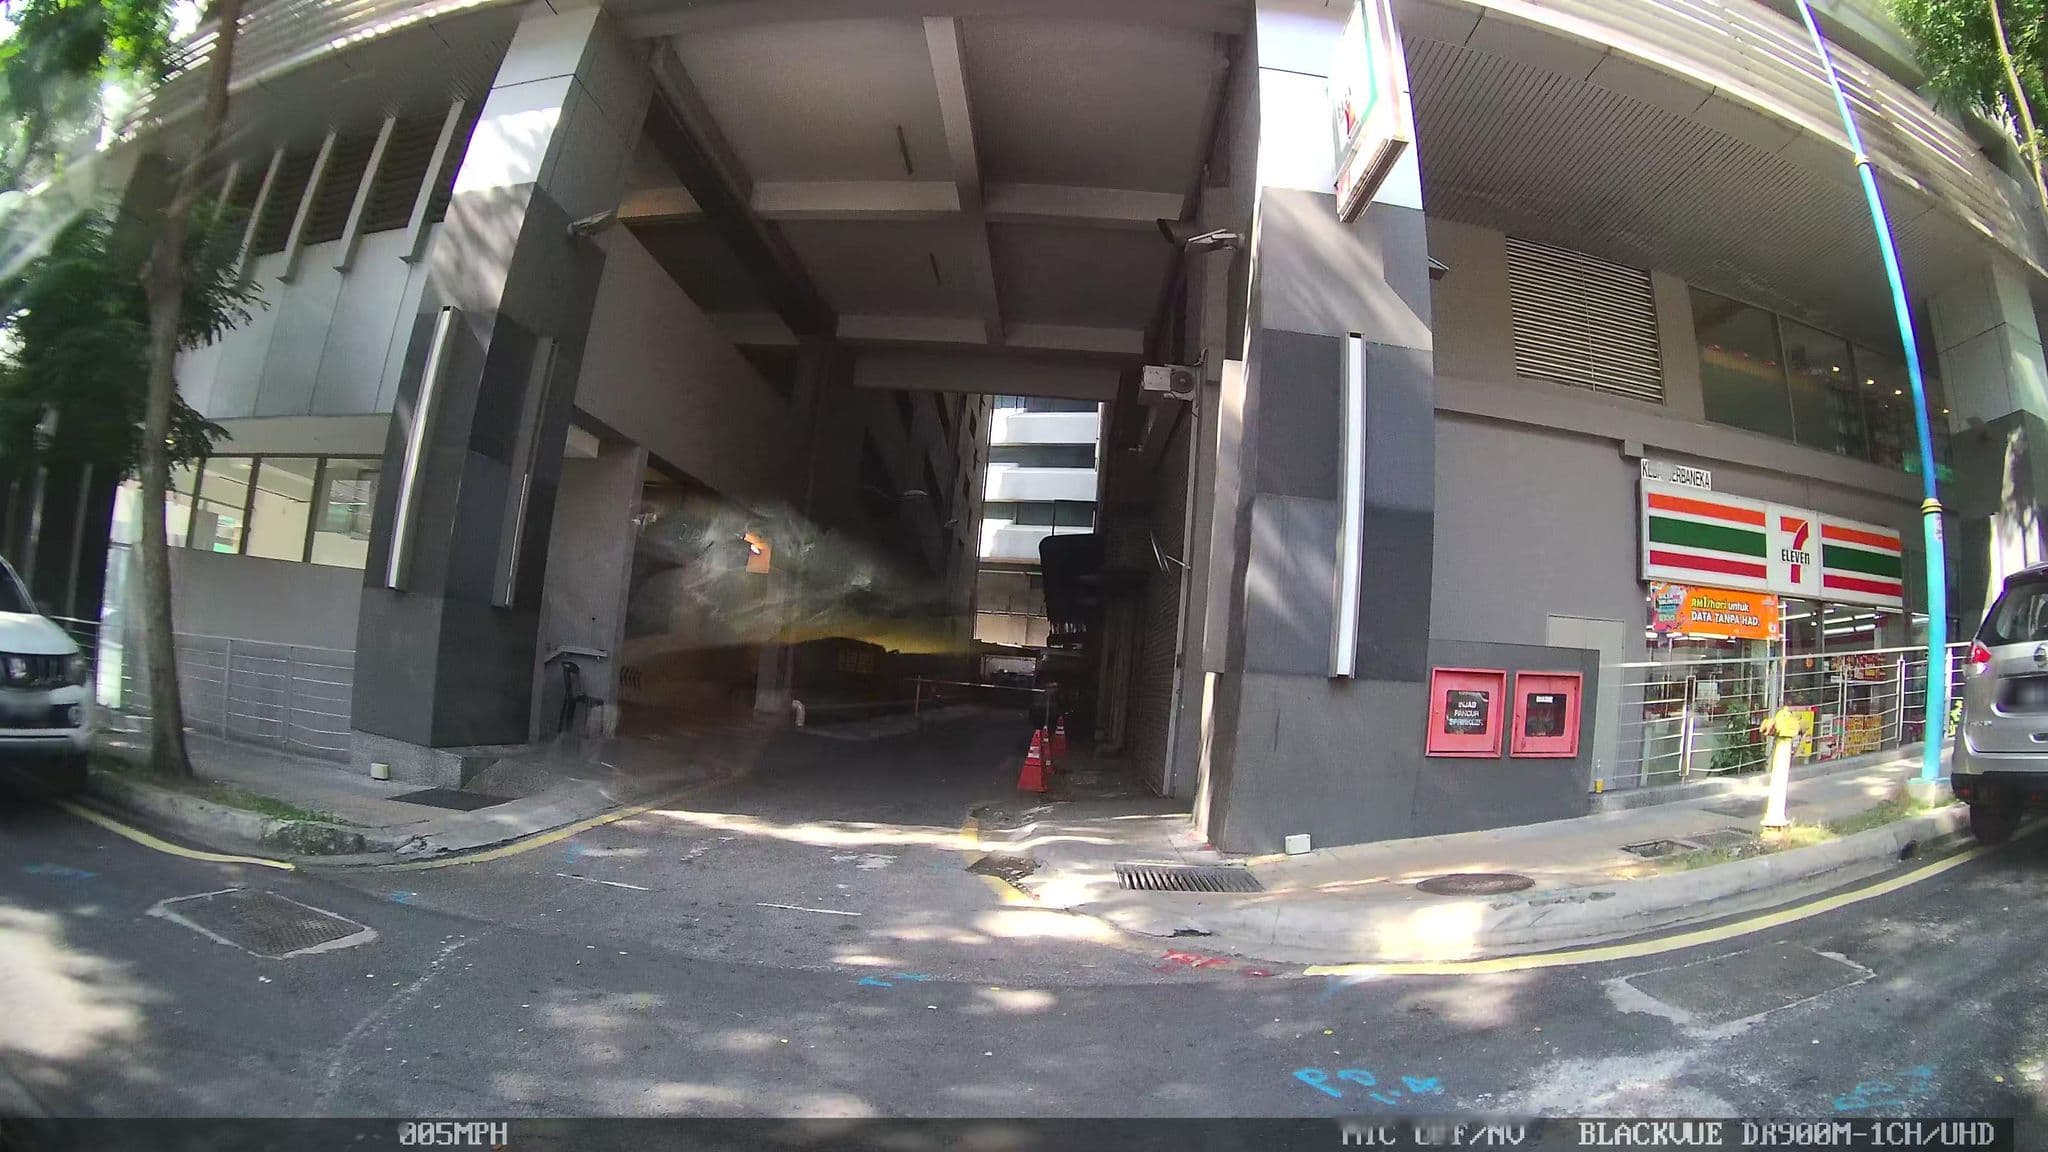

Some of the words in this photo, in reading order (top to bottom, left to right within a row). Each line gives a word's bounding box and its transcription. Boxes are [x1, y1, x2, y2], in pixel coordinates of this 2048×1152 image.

[1780, 516, 1809, 583] 7
[1728, 602, 1749, 611] untuk
[1691, 611, 1712, 622] DATA
[1714, 613, 1740, 624] TANPA
